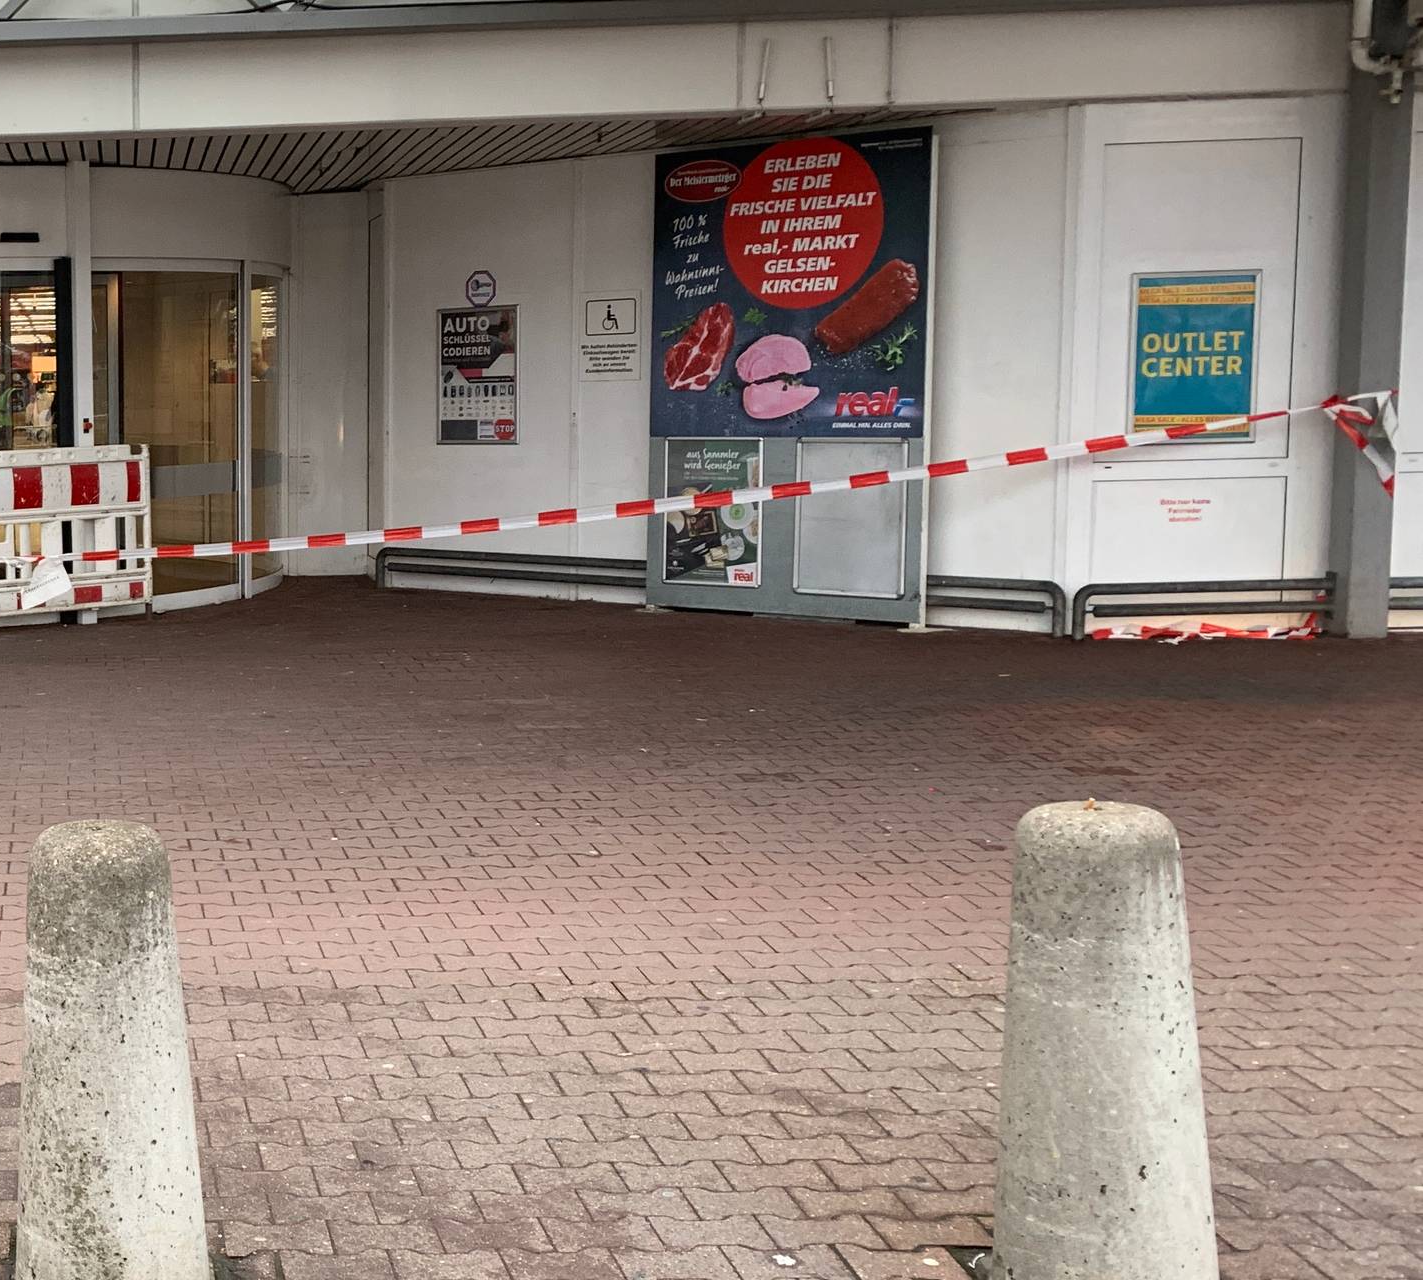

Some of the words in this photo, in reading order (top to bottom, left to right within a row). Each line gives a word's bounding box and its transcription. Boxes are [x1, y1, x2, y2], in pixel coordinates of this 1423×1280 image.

[764, 152, 841, 174] ERLEBEN
[771, 176, 800, 193] SIE
[801, 173, 833, 190] DIE
[729, 198, 797, 217] FRISCHE
[800, 191, 877, 211] VIELFALT
[673, 214, 695, 233] 100
[697, 213, 708, 228] %
[760, 219, 780, 235] IN
[783, 214, 842, 232] IHREM
[672, 231, 711, 249] Frische
[743, 238, 788, 256] real,-
[791, 234, 860, 253] MARKT
[686, 252, 699, 263] zu
[764, 256, 836, 274] GELSEN-
[675, 278, 720, 300] Preisen!
[761, 276, 839, 294] KIRCHEN
[443, 316, 490, 333] AUTO
[443, 333, 491, 344] SCHLÜSSEL
[1142, 330, 1245, 353] OUTLET
[442, 346, 491, 357] CODIEREN
[1141, 355, 1243, 378] CENTER
[495, 425, 515, 433] STOP
[686, 451, 701, 459] aus
[703, 448, 740, 460] Sammler
[683, 459, 702, 470] wird
[704, 459, 741, 473] Genießer
[734, 571, 754, 582] real
